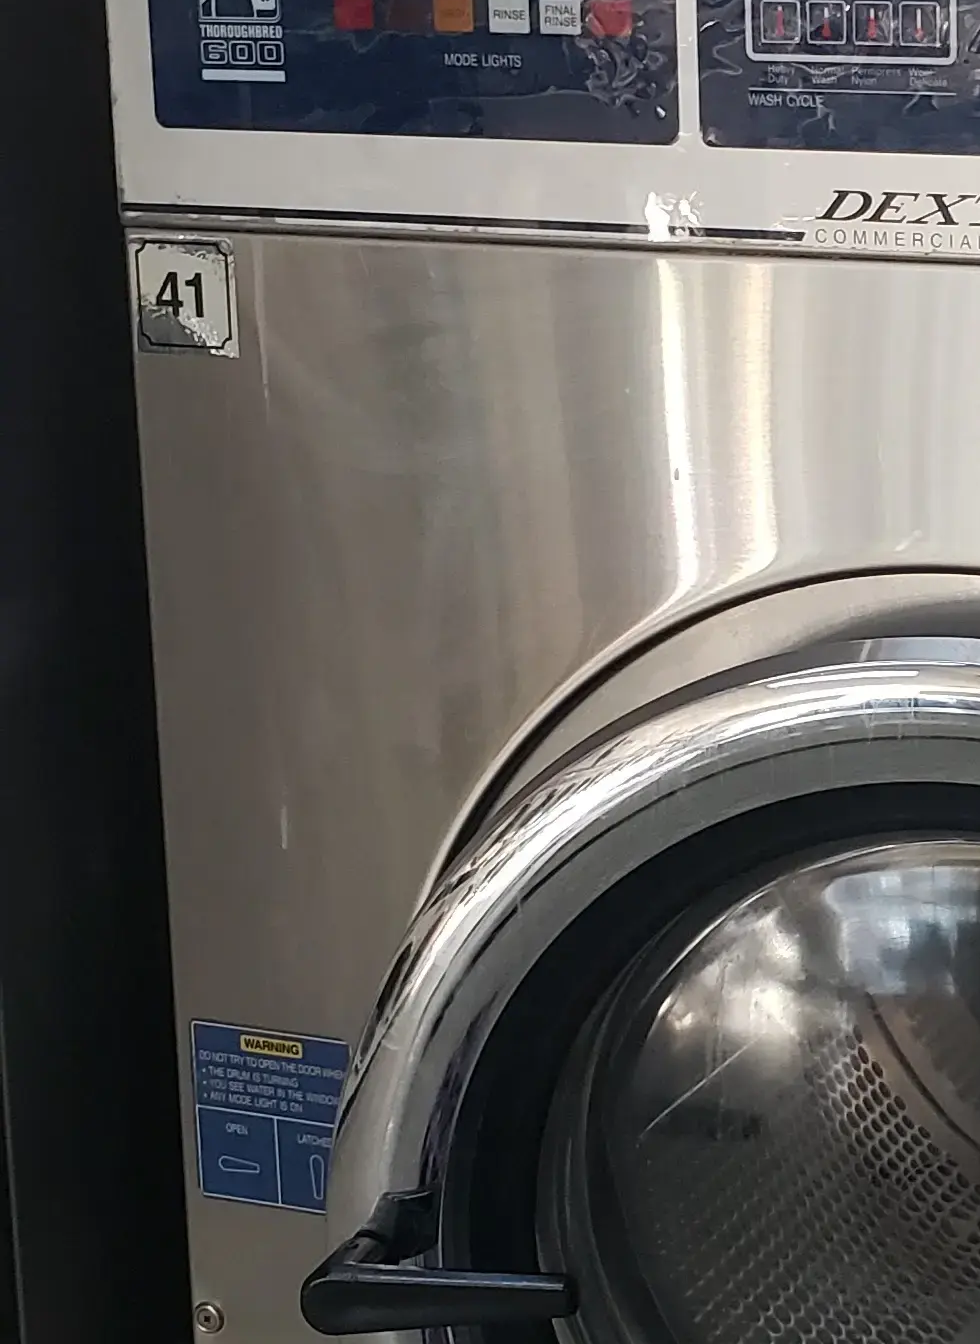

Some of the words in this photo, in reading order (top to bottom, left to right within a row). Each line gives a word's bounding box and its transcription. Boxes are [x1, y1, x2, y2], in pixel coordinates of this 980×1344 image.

[493, 9, 527, 21] RINSE
[545, 5, 577, 16] FINAL
[544, 16, 578, 28] RINSE
[199, 24, 283, 39] THOROUGHBRED
[200, 40, 285, 65] 600
[444, 53, 478, 67] MODE
[482, 54, 522, 68] LIGHTS
[748, 94, 782, 106] WASH
[786, 95, 824, 108] CYCLE
[156, 271, 204, 318] 41
[244, 1037, 299, 1055] WARNING
[212, 1051, 228, 1063] NOT
[230, 1053, 244, 1066] TRY
[246, 1056, 257, 1068] TO
[259, 1058, 279, 1071] OPEN
[281, 1061, 296, 1073] THE
[298, 1063, 321, 1076] DOOR
[208, 1065, 224, 1077] THE
[226, 1068, 250, 1081] DRUM
[263, 1074, 299, 1088] TURNING
[209, 1078, 227, 1090] YOU
[228, 1081, 245, 1093] SEE
[246, 1083, 275, 1097] WATER
[276, 1087, 286, 1098] IN
[288, 1089, 304, 1101] THE
[209, 1091, 226, 1103] ANY
[229, 1093, 252, 1106] MODE
[254, 1096, 277, 1110] LIGHT
[290, 1102, 303, 1114] ON
[225, 1122, 249, 1135] OPEN
